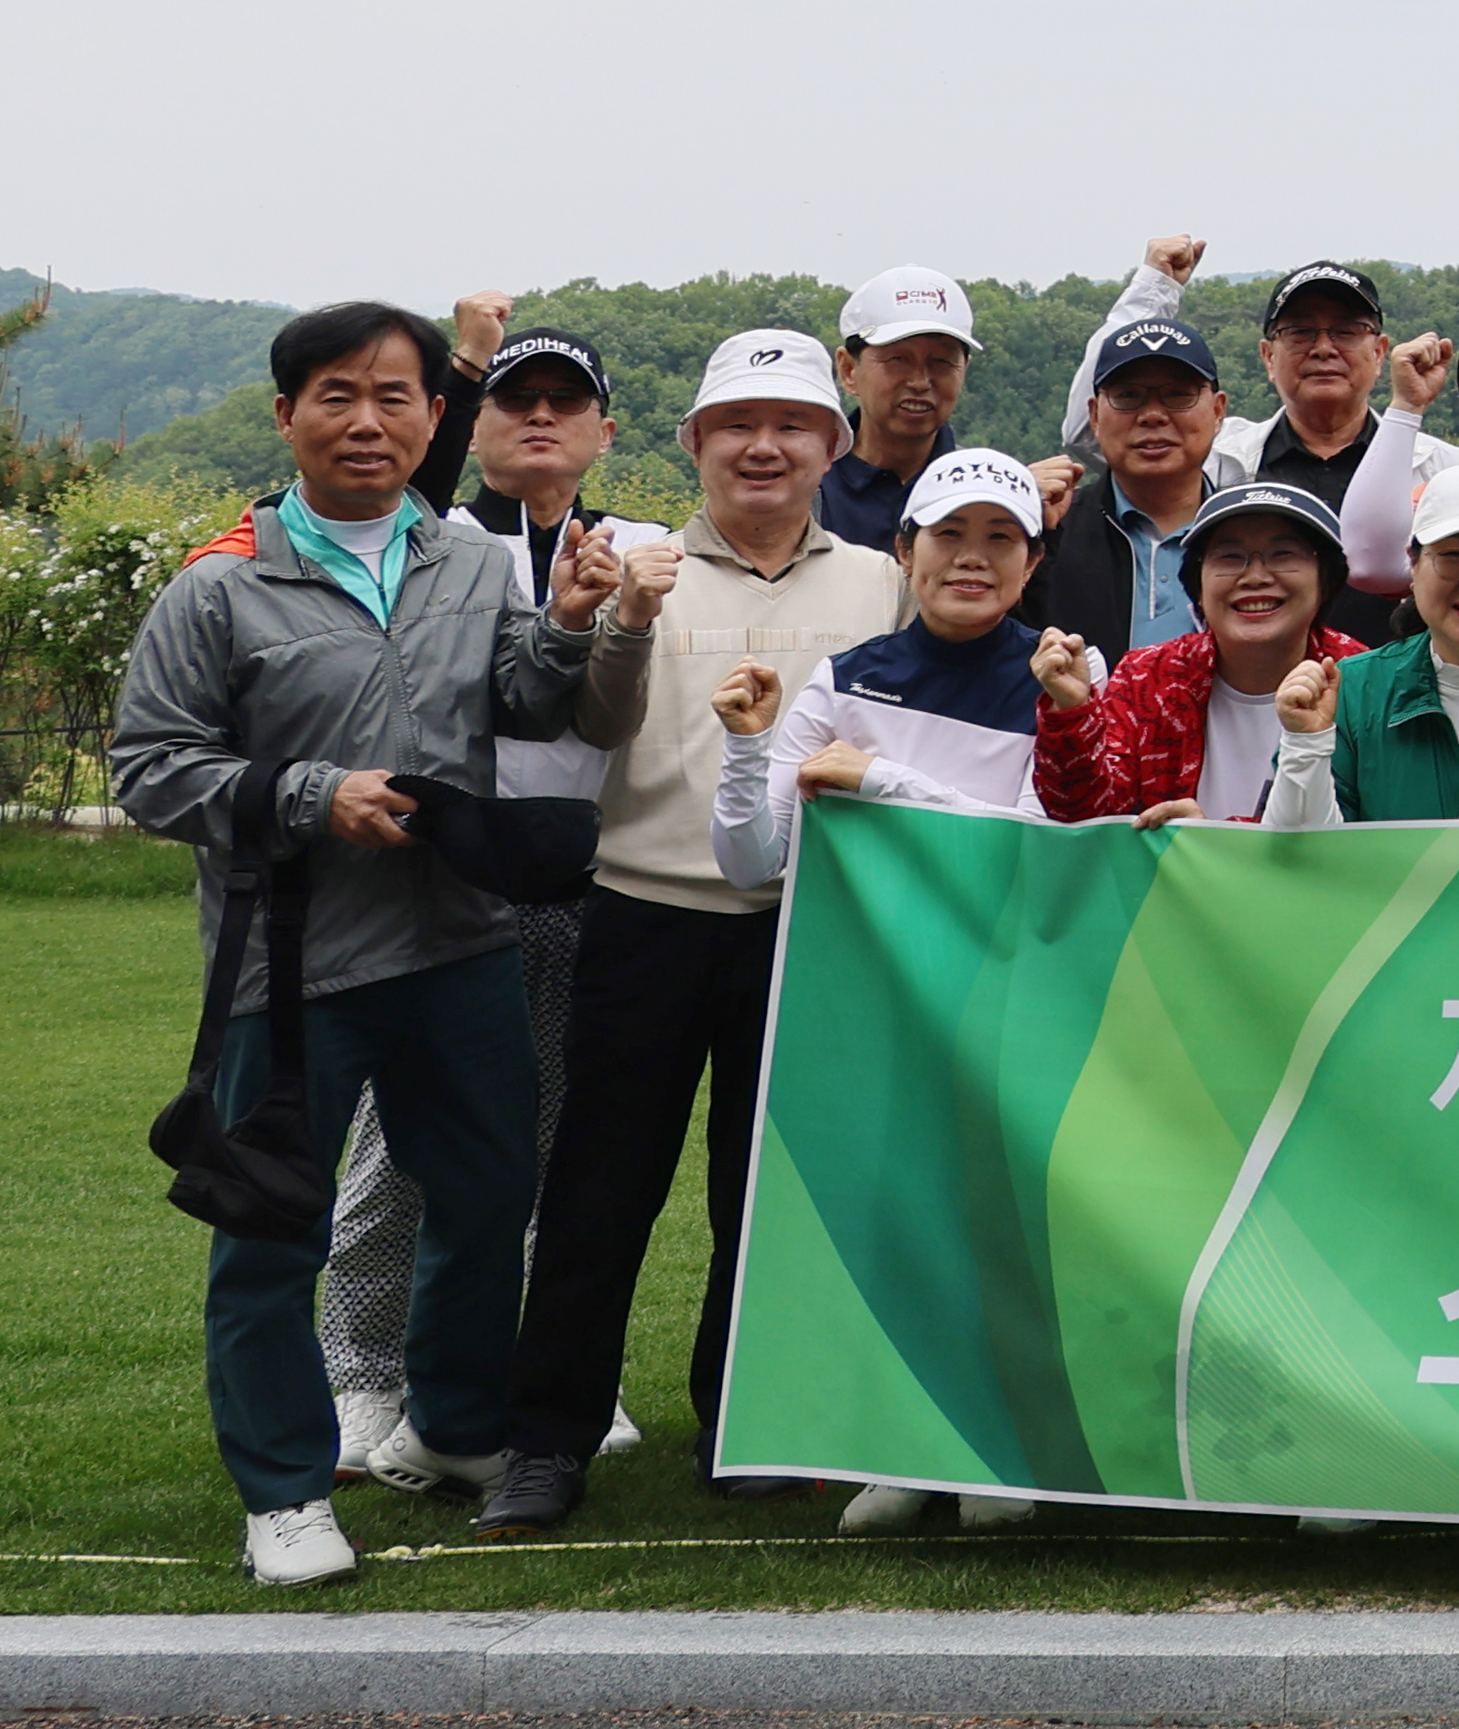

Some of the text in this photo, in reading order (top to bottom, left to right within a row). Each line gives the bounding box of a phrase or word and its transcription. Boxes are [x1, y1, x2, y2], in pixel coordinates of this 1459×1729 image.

[1115, 323, 1192, 348] Callaway
[492, 337, 594, 367] MEDIHEAL
[932, 461, 1032, 497] TAYLOR
[952, 473, 1018, 493] MADE
